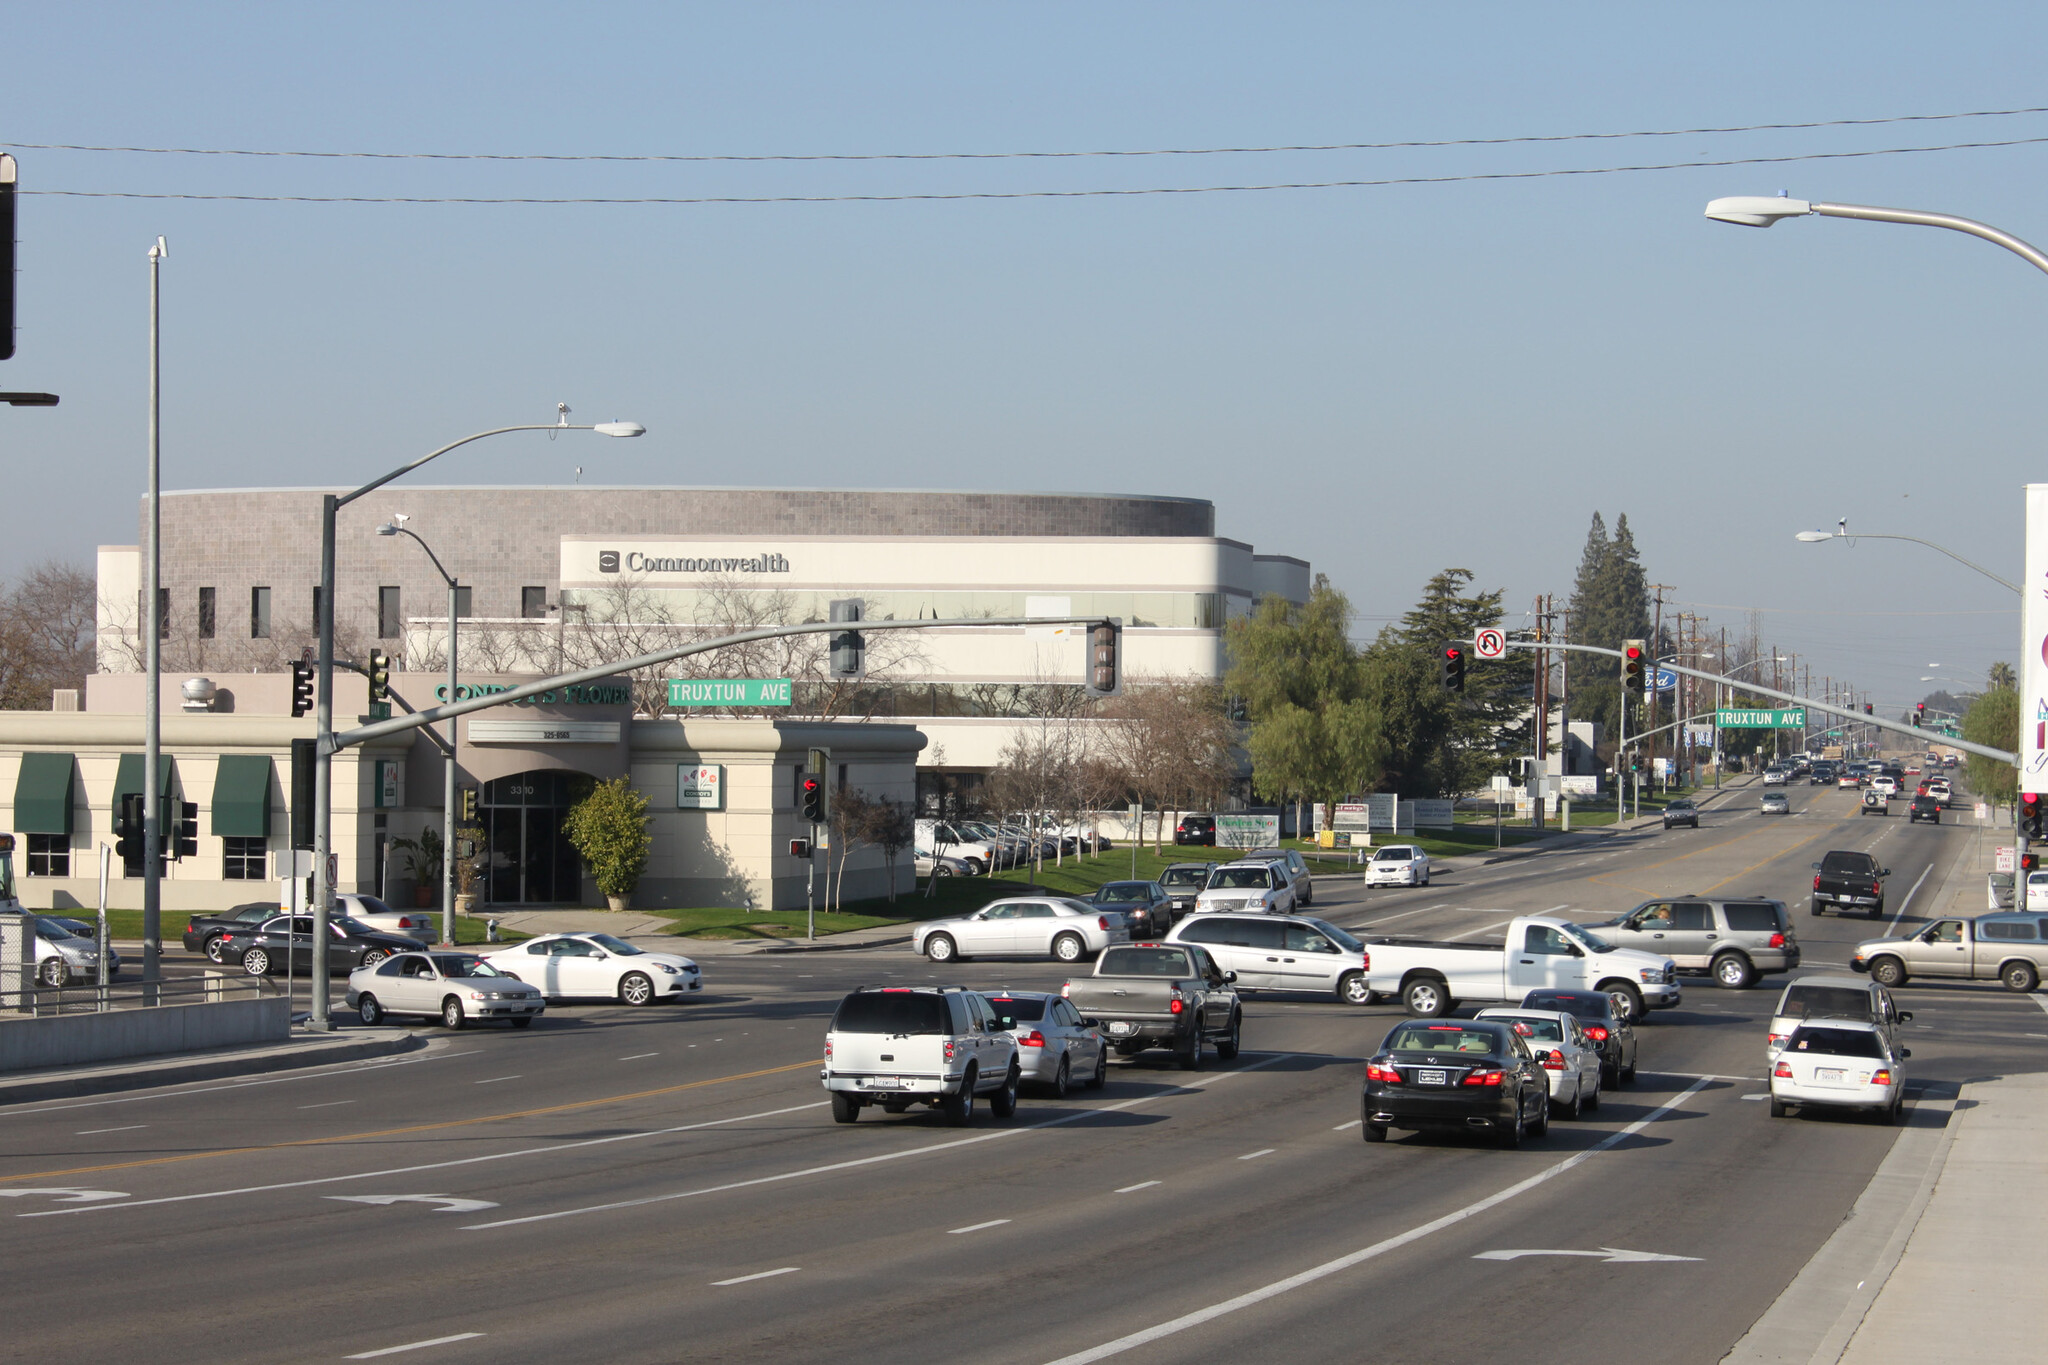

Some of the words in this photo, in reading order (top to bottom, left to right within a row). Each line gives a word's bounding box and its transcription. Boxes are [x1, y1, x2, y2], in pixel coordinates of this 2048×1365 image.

[626, 551, 790, 573] Commonwealth
[564, 685, 631, 704] FLOWERS
[672, 682, 746, 702] TRUXTUN
[760, 682, 789, 702] AVE
[1719, 712, 1773, 726] TRUXTUN
[1781, 712, 1804, 726] AVE
[510, 785, 534, 795] 3310
[1255, 818, 1276, 828] Spot
